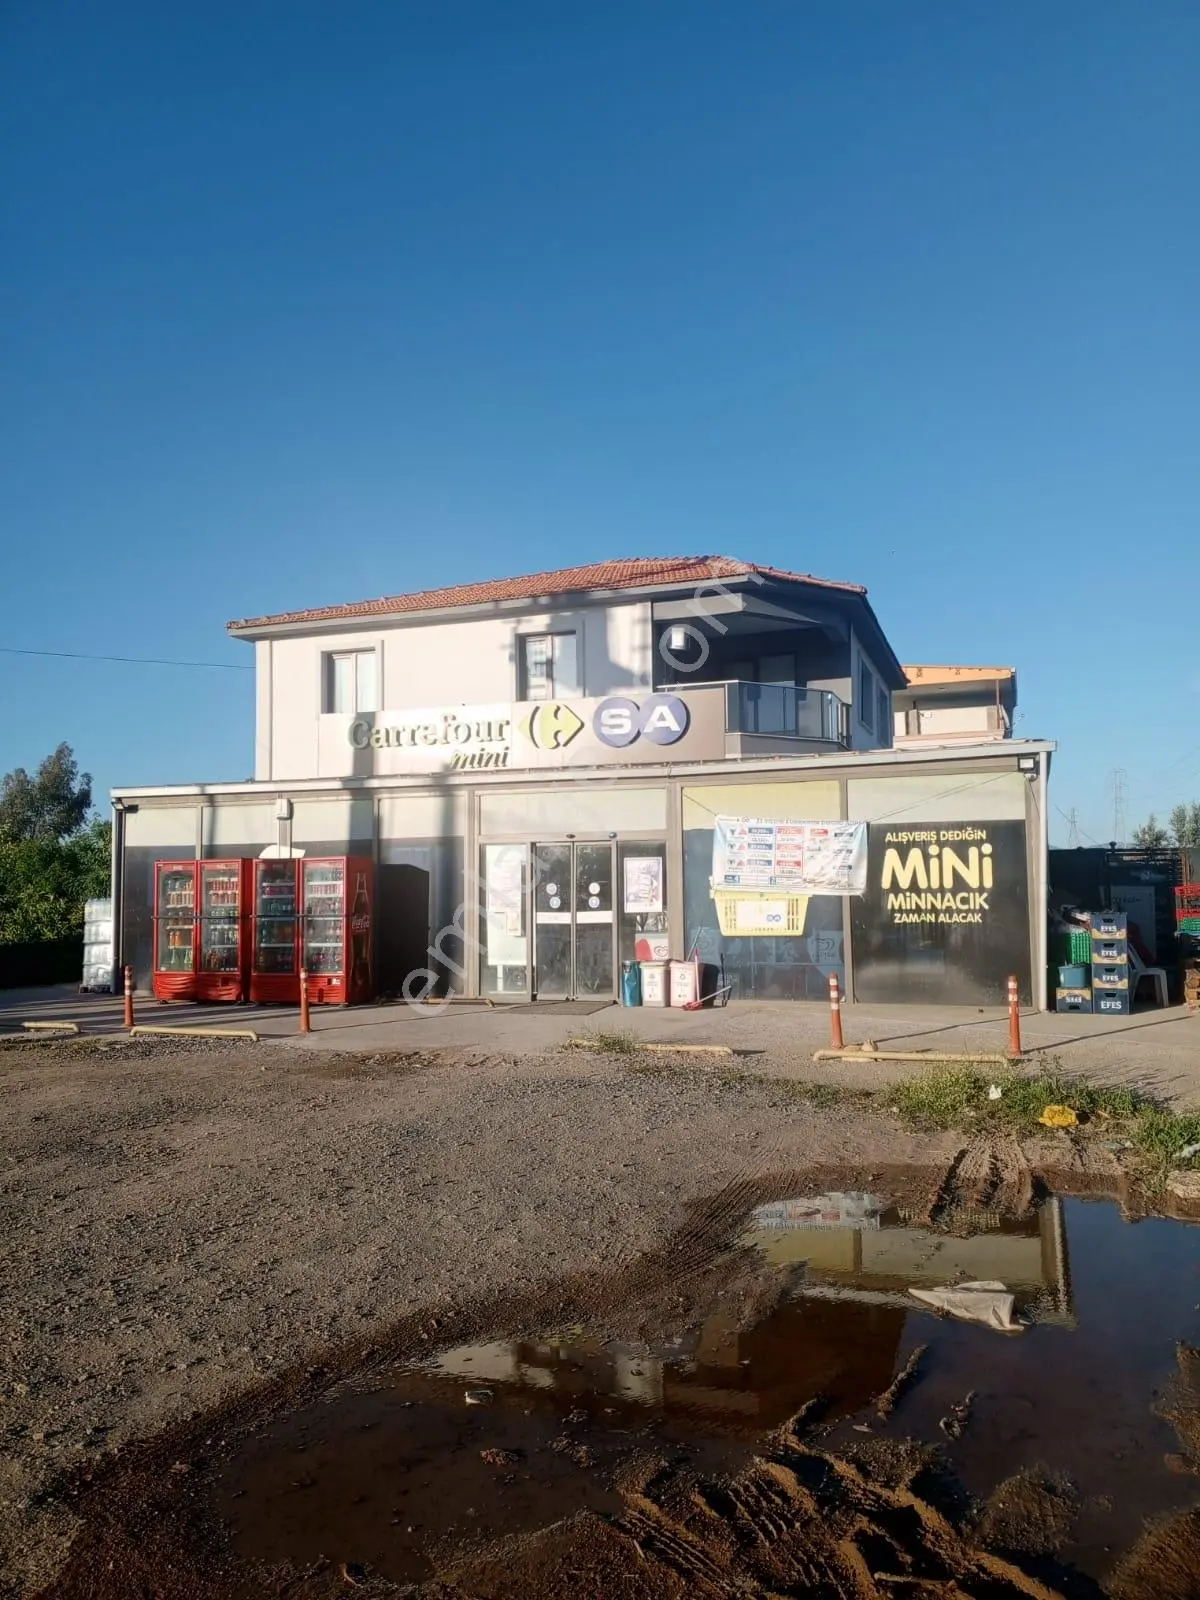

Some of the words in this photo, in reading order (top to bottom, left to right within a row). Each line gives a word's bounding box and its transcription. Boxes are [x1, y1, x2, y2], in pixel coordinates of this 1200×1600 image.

[348, 712, 511, 750] Carrefour
[451, 746, 510, 770] mini
[894, 913, 935, 923] ZAMAN
[938, 912, 982, 923] ALACAK
[1100, 1001, 1122, 1009] EFES
